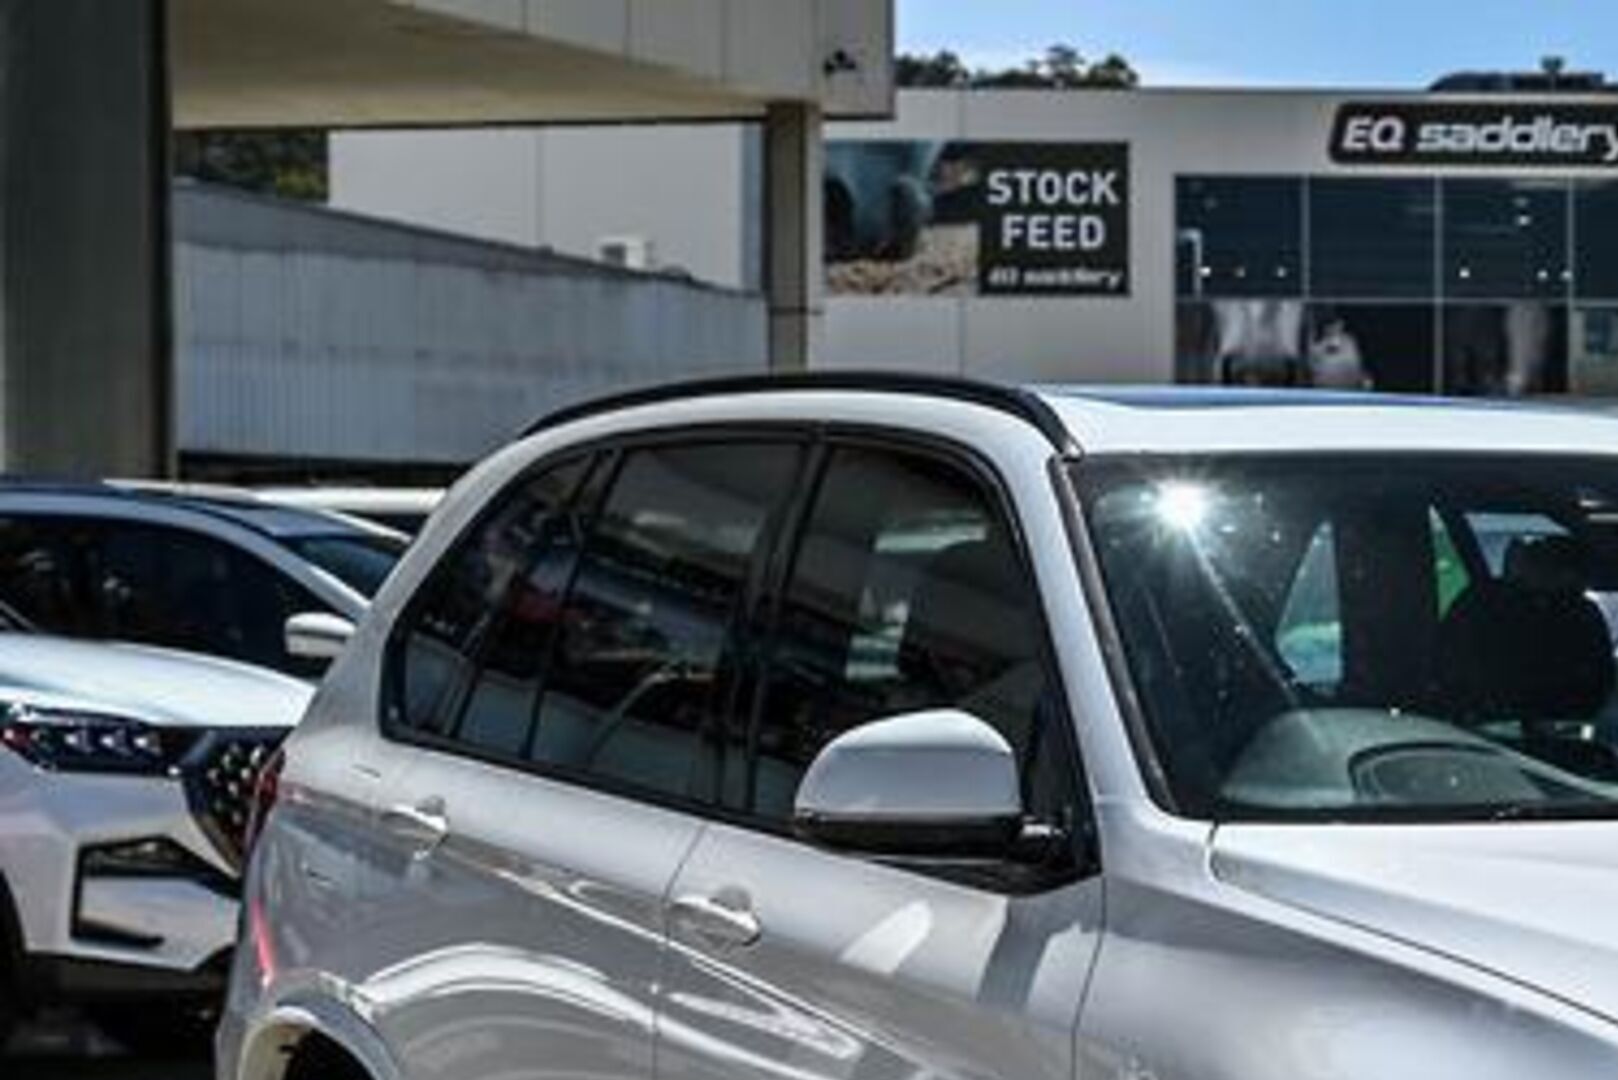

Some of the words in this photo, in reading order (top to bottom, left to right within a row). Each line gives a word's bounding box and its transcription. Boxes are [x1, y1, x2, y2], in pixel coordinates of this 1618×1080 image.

[1339, 115, 1402, 154] EQ
[986, 170, 1120, 206] STOCK
[1001, 213, 1106, 249] FEED
